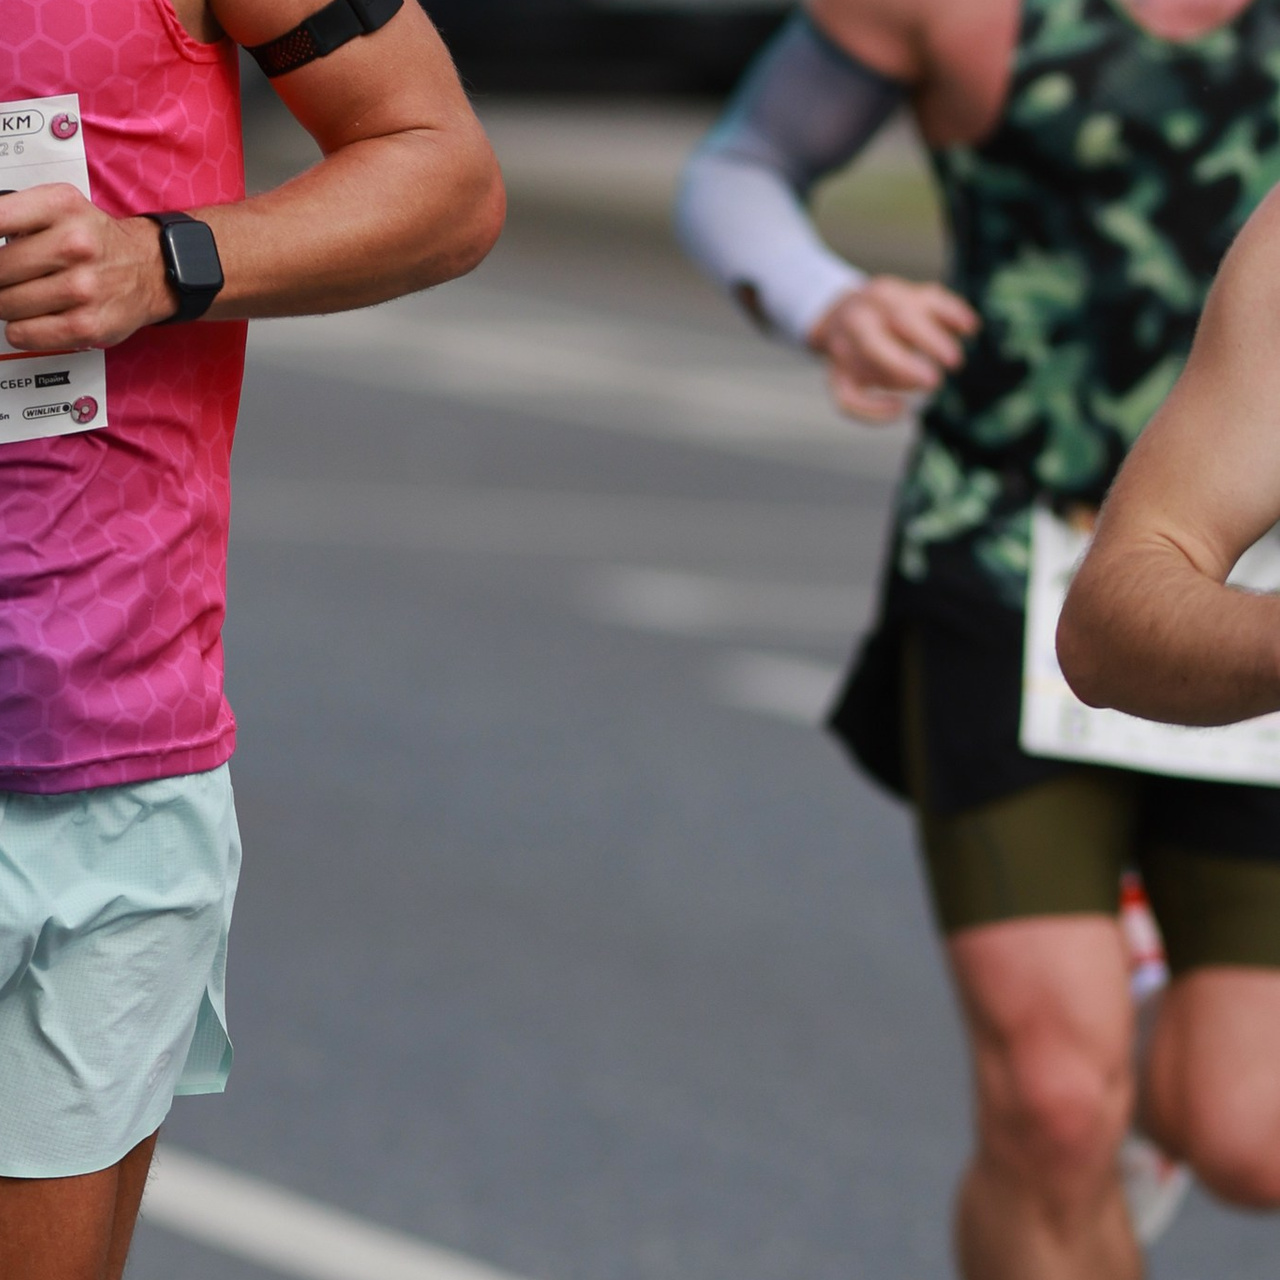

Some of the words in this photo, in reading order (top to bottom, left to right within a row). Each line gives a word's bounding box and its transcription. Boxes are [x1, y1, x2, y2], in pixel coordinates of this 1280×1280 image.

[2, 114, 31, 131] КМ
[0, 378, 33, 390] СБЕР
[26, 405, 62, 418] WINLINE
